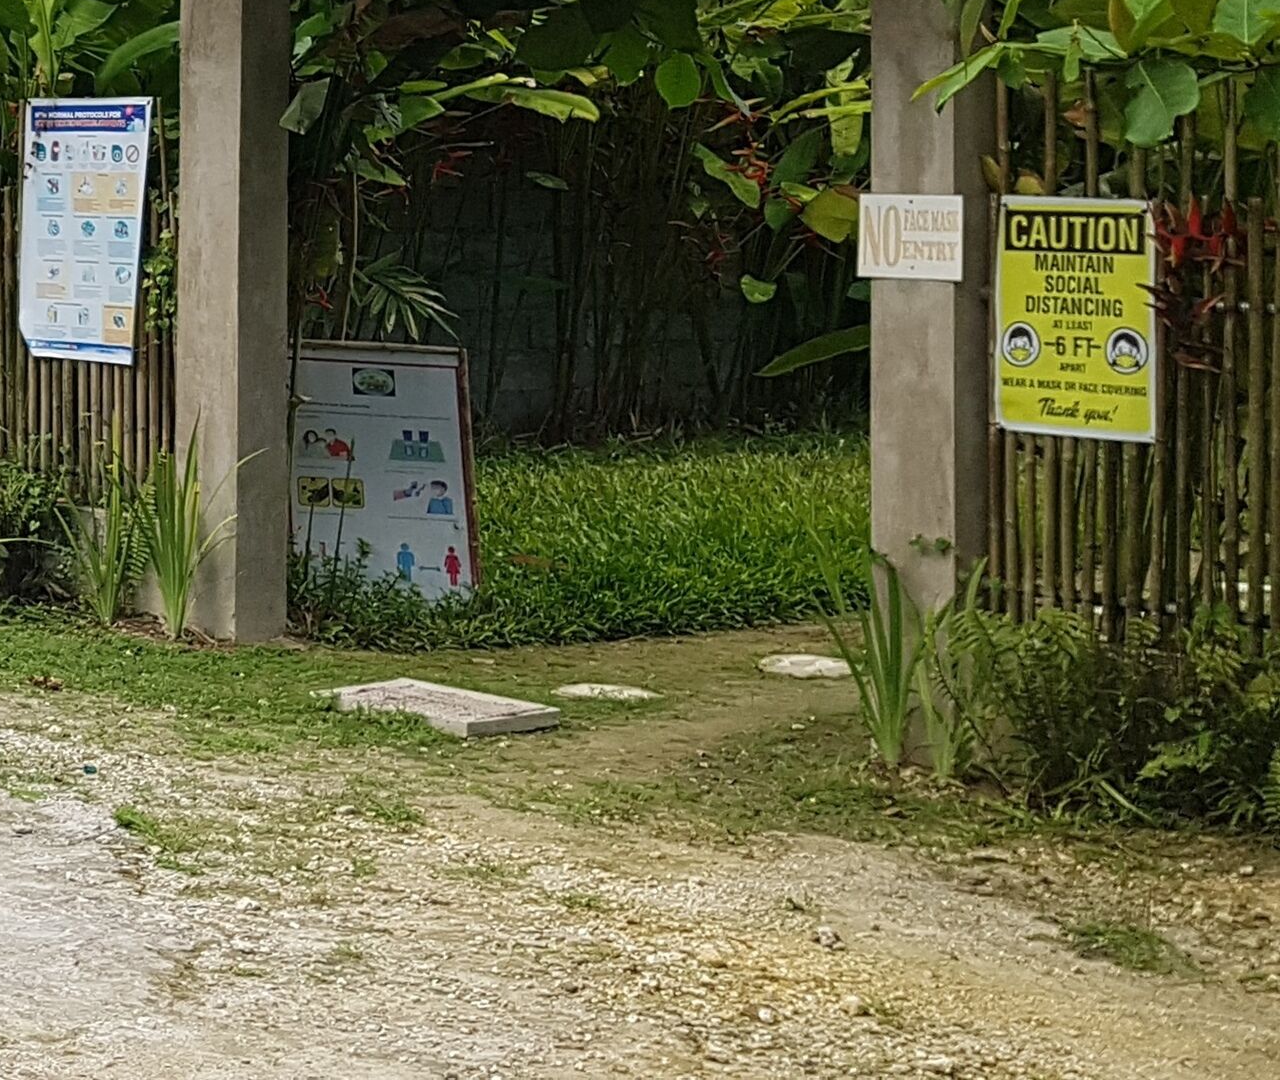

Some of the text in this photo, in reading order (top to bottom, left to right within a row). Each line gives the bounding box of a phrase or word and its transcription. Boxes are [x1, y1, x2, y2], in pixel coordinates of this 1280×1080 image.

[903, 209, 930, 232] FACE
[863, 205, 902, 267] NO
[1010, 214, 1139, 251] CAUTION
[901, 240, 959, 261] ENTRY
[1034, 253, 1115, 274] MAINTAIN
[1044, 274, 1105, 296] SOCIAL
[1025, 294, 1124, 318] DISTANCING
[1052, 319, 1093, 331] AT LEAST
[1059, 362, 1086, 373] APART
[1001, 377, 1027, 388] WEAR
[1028, 378, 1036, 388] A
[1037, 379, 1062, 391] MASK
[1037, 396, 1119, 425] Thank you!
